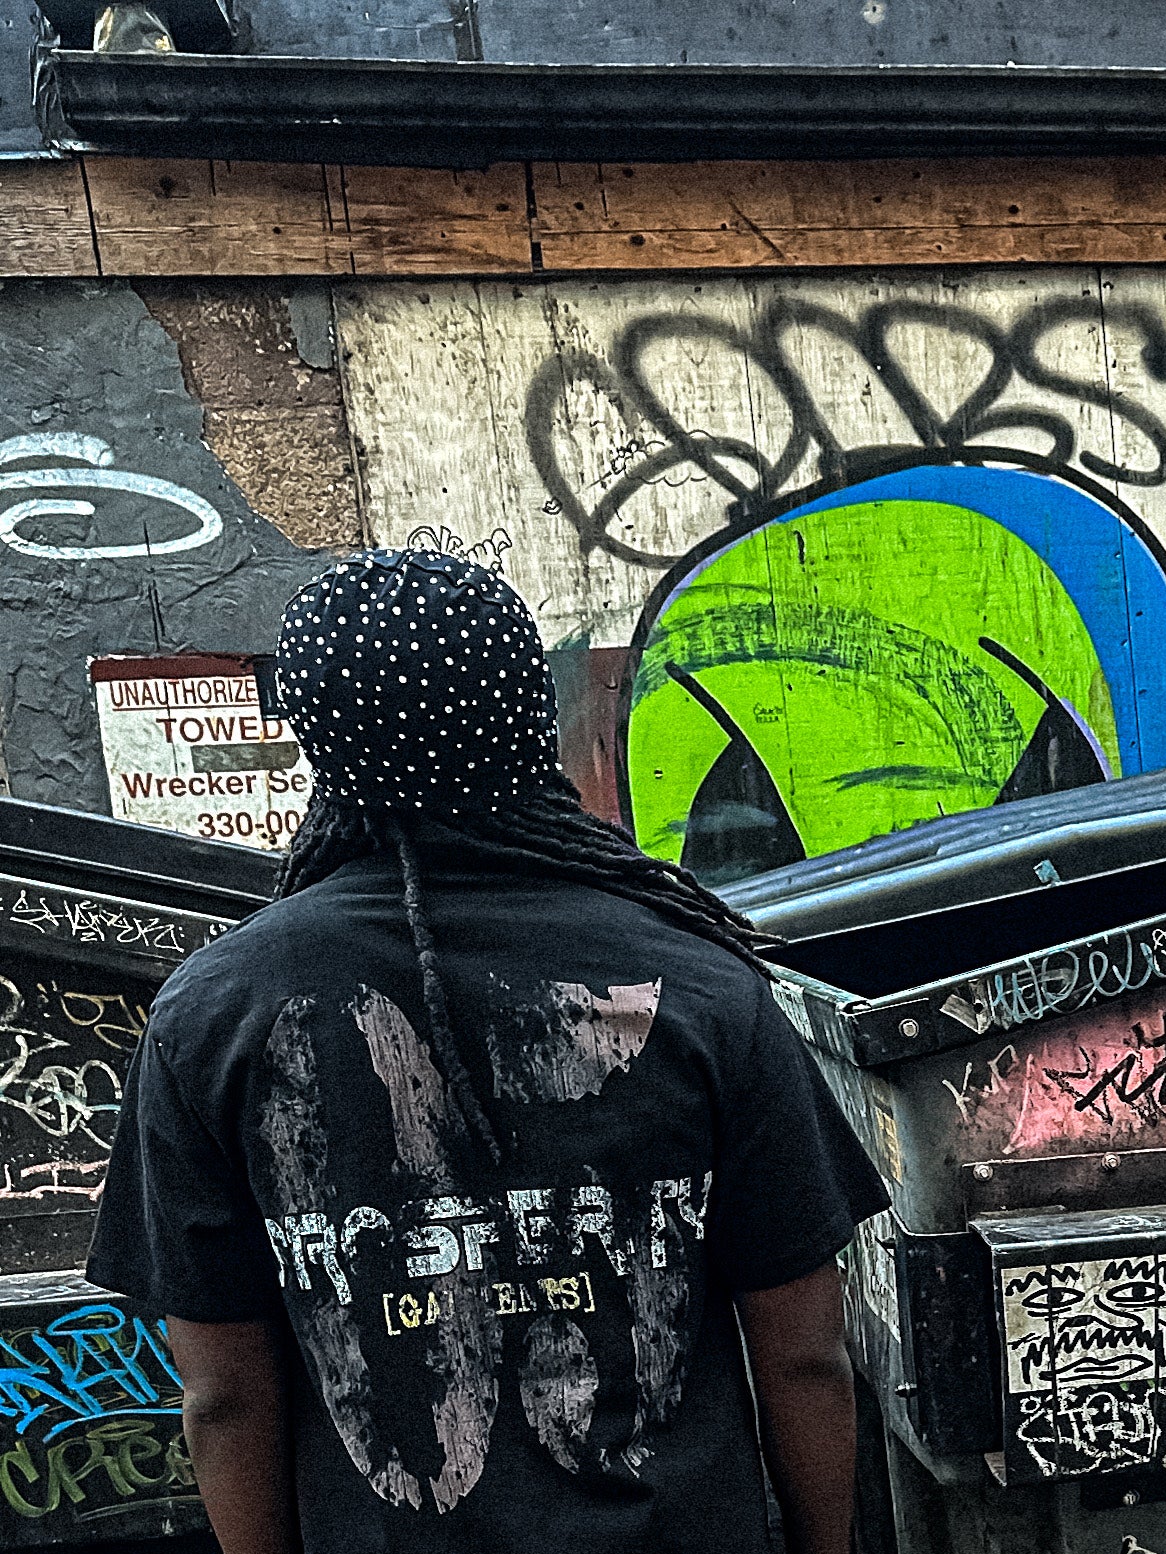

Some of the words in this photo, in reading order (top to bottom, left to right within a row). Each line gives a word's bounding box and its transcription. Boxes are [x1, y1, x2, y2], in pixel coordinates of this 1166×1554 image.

[110, 679, 259, 707] UNAUTHORIZE
[156, 715, 284, 744] TOWED
[121, 769, 257, 799] Wrecker
[267, 768, 308, 794] Se
